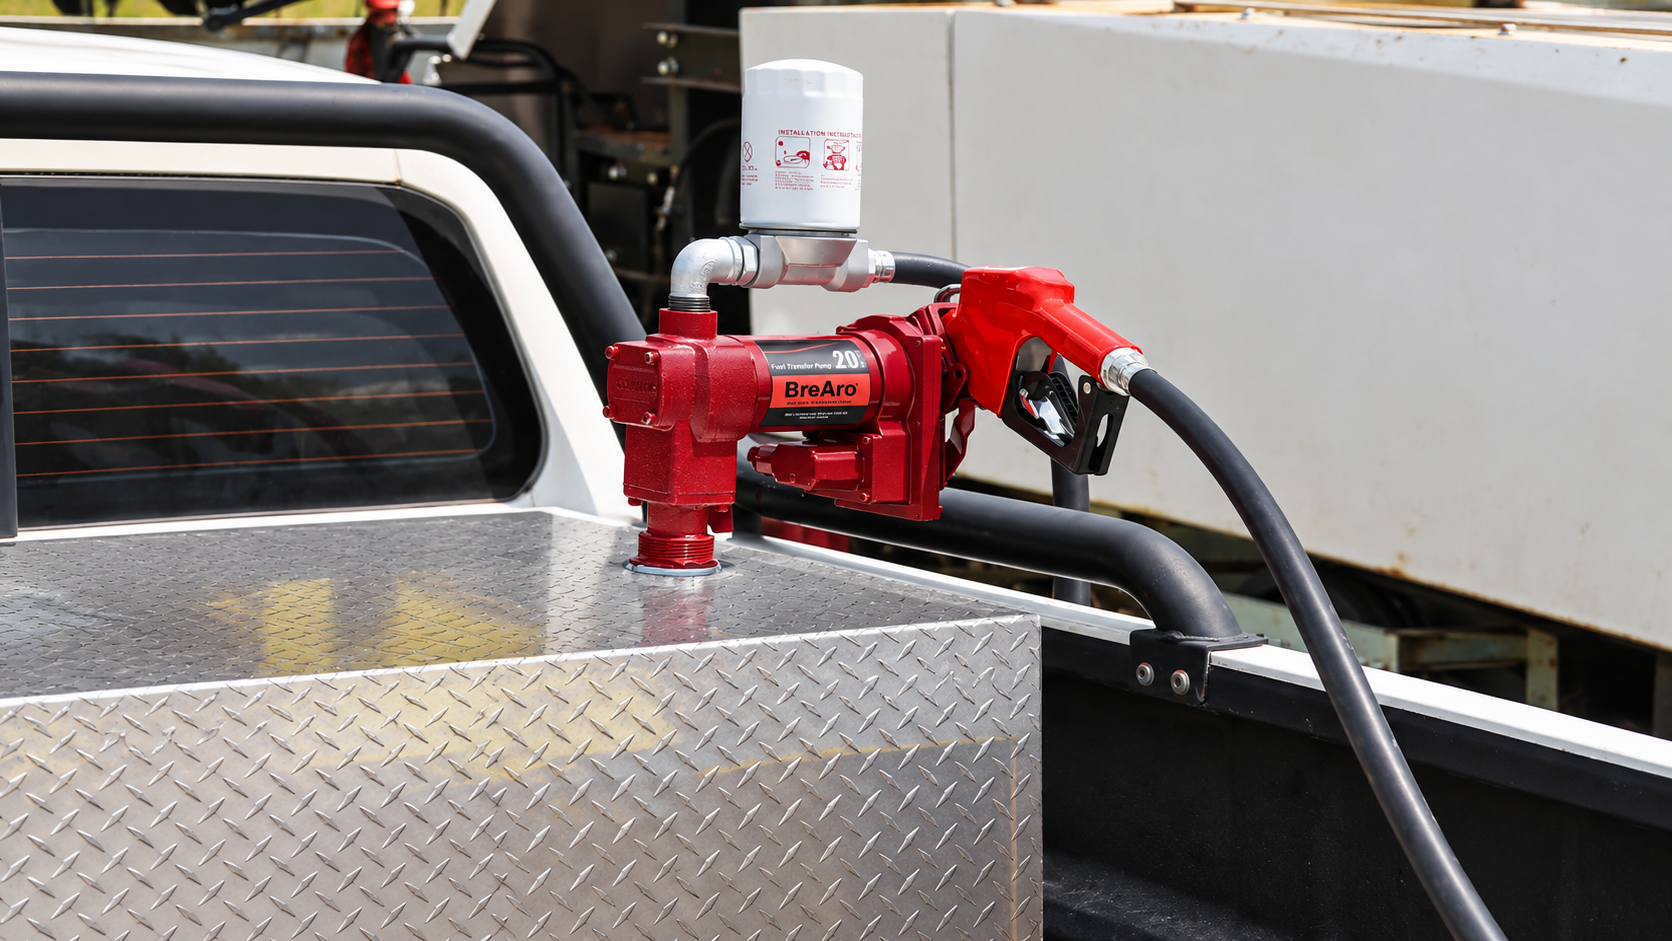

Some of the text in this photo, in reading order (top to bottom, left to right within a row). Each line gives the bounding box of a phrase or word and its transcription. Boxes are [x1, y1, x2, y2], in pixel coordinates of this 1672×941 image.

[778, 129, 826, 137] INSTALLATION
[832, 350, 859, 369] 20
[785, 380, 856, 398] BreAro
